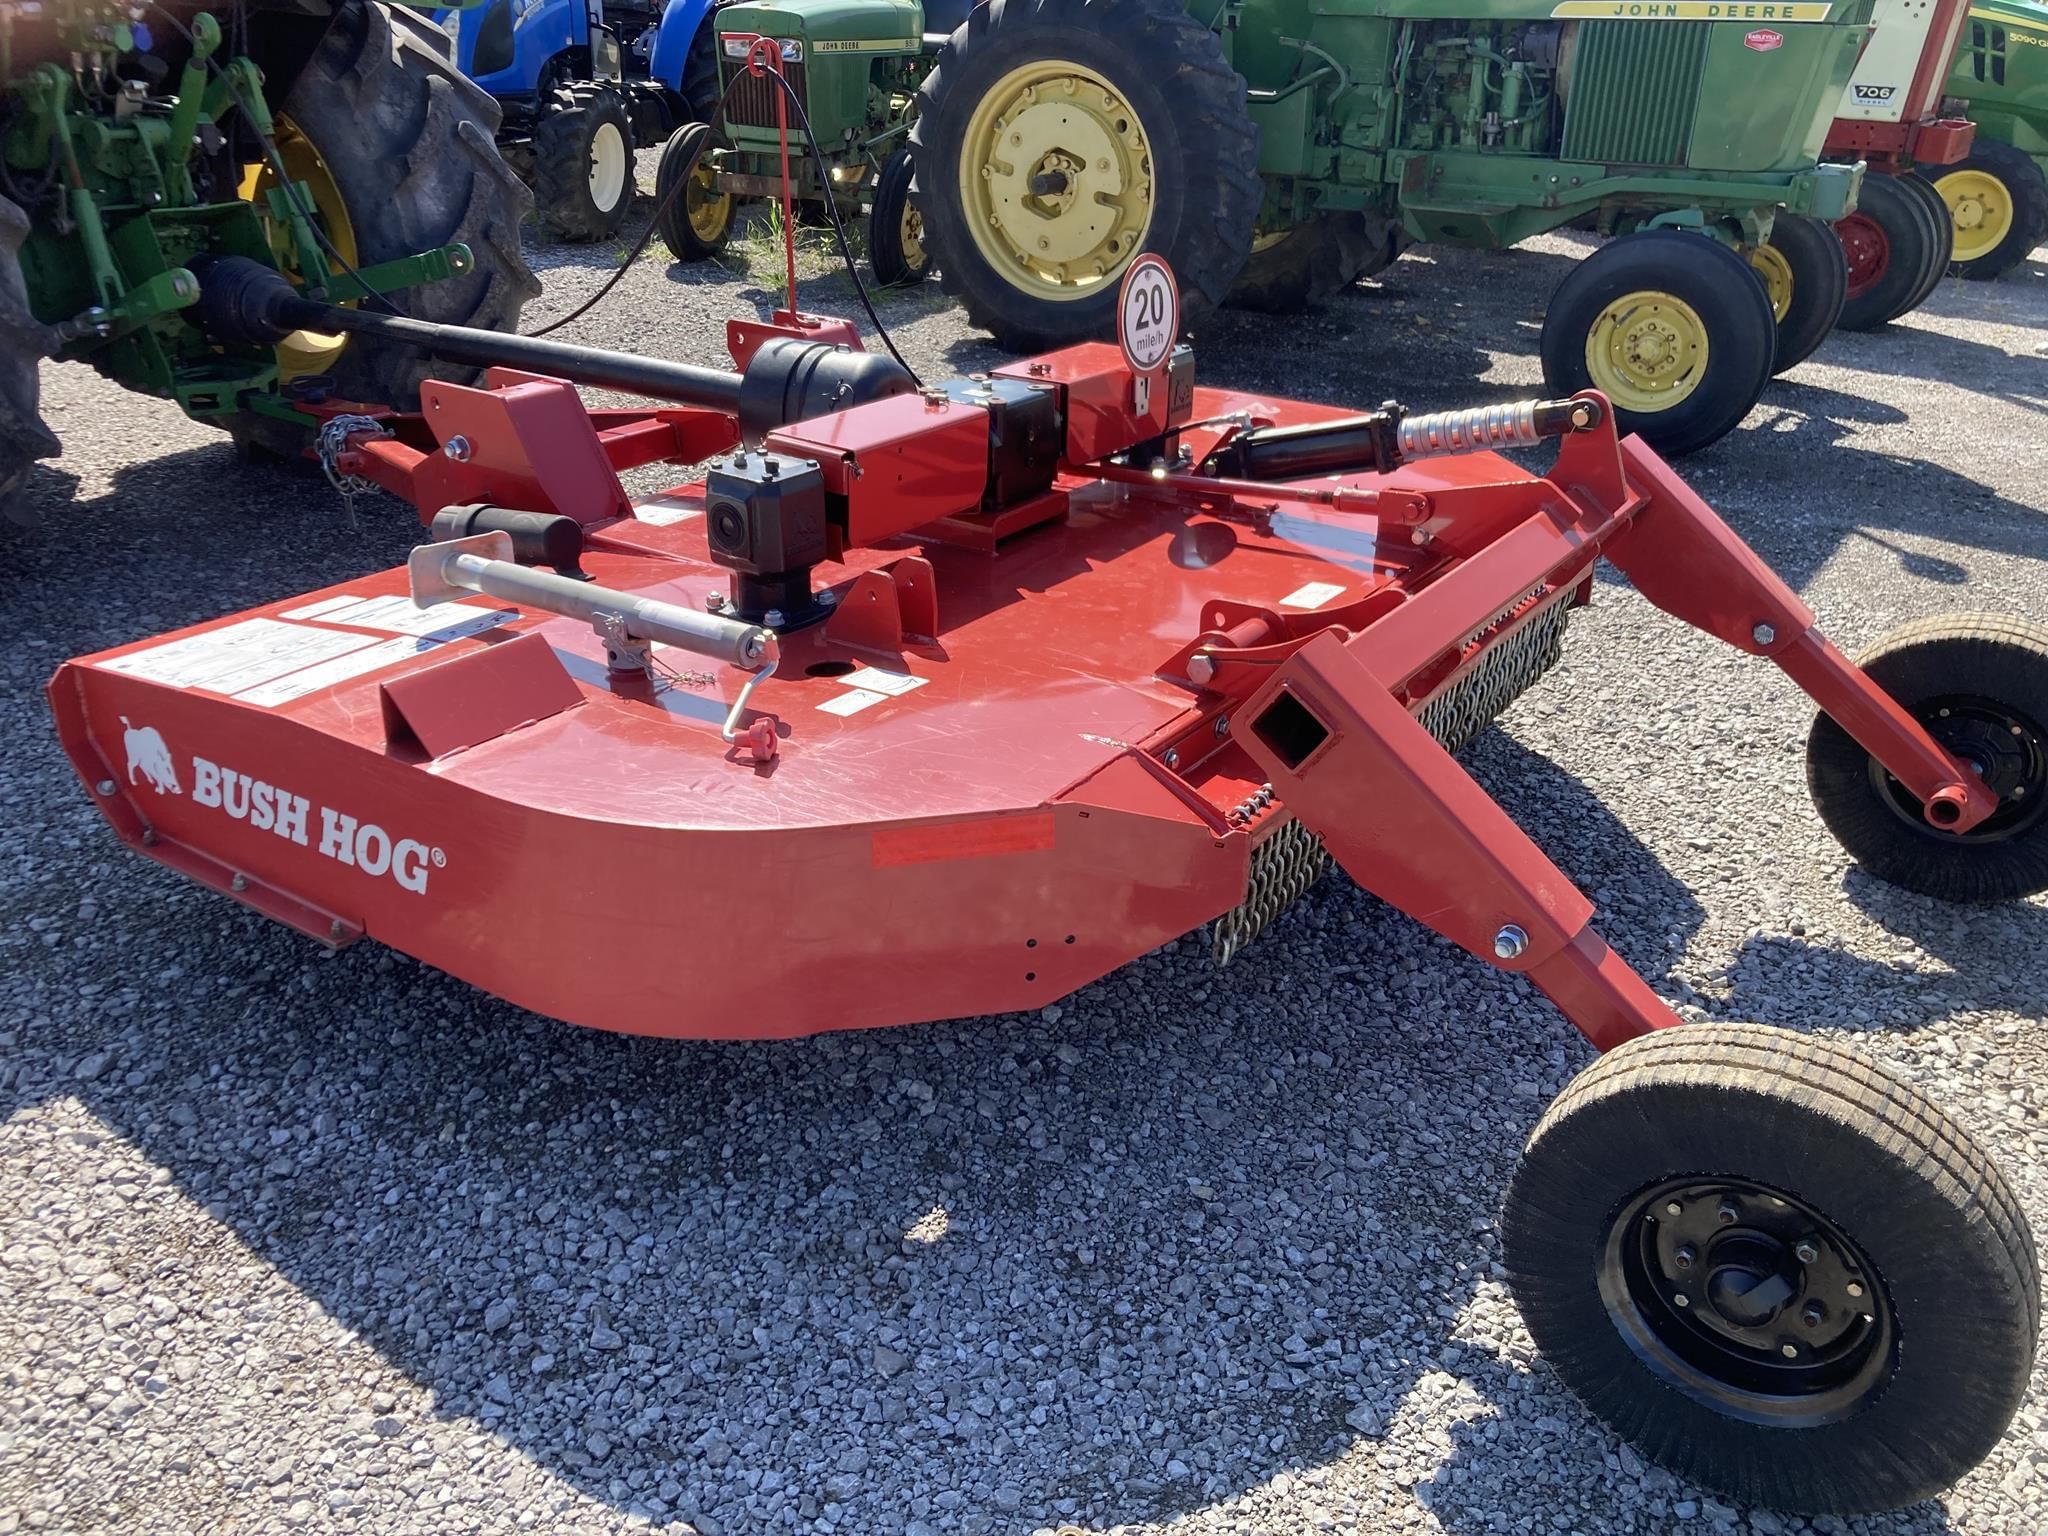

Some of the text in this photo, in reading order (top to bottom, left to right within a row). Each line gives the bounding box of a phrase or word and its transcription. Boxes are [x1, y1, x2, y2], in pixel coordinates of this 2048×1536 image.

[1614, 4, 1793, 18] JOHN DEERE
[822, 40, 860, 51] JOHN DEERE
[2009, 32, 2037, 45] 5090
[1858, 86, 1890, 98] 706
[1134, 284, 1164, 331] 20
[1136, 331, 1164, 352] mile/h
[193, 756, 310, 846] BUSH
